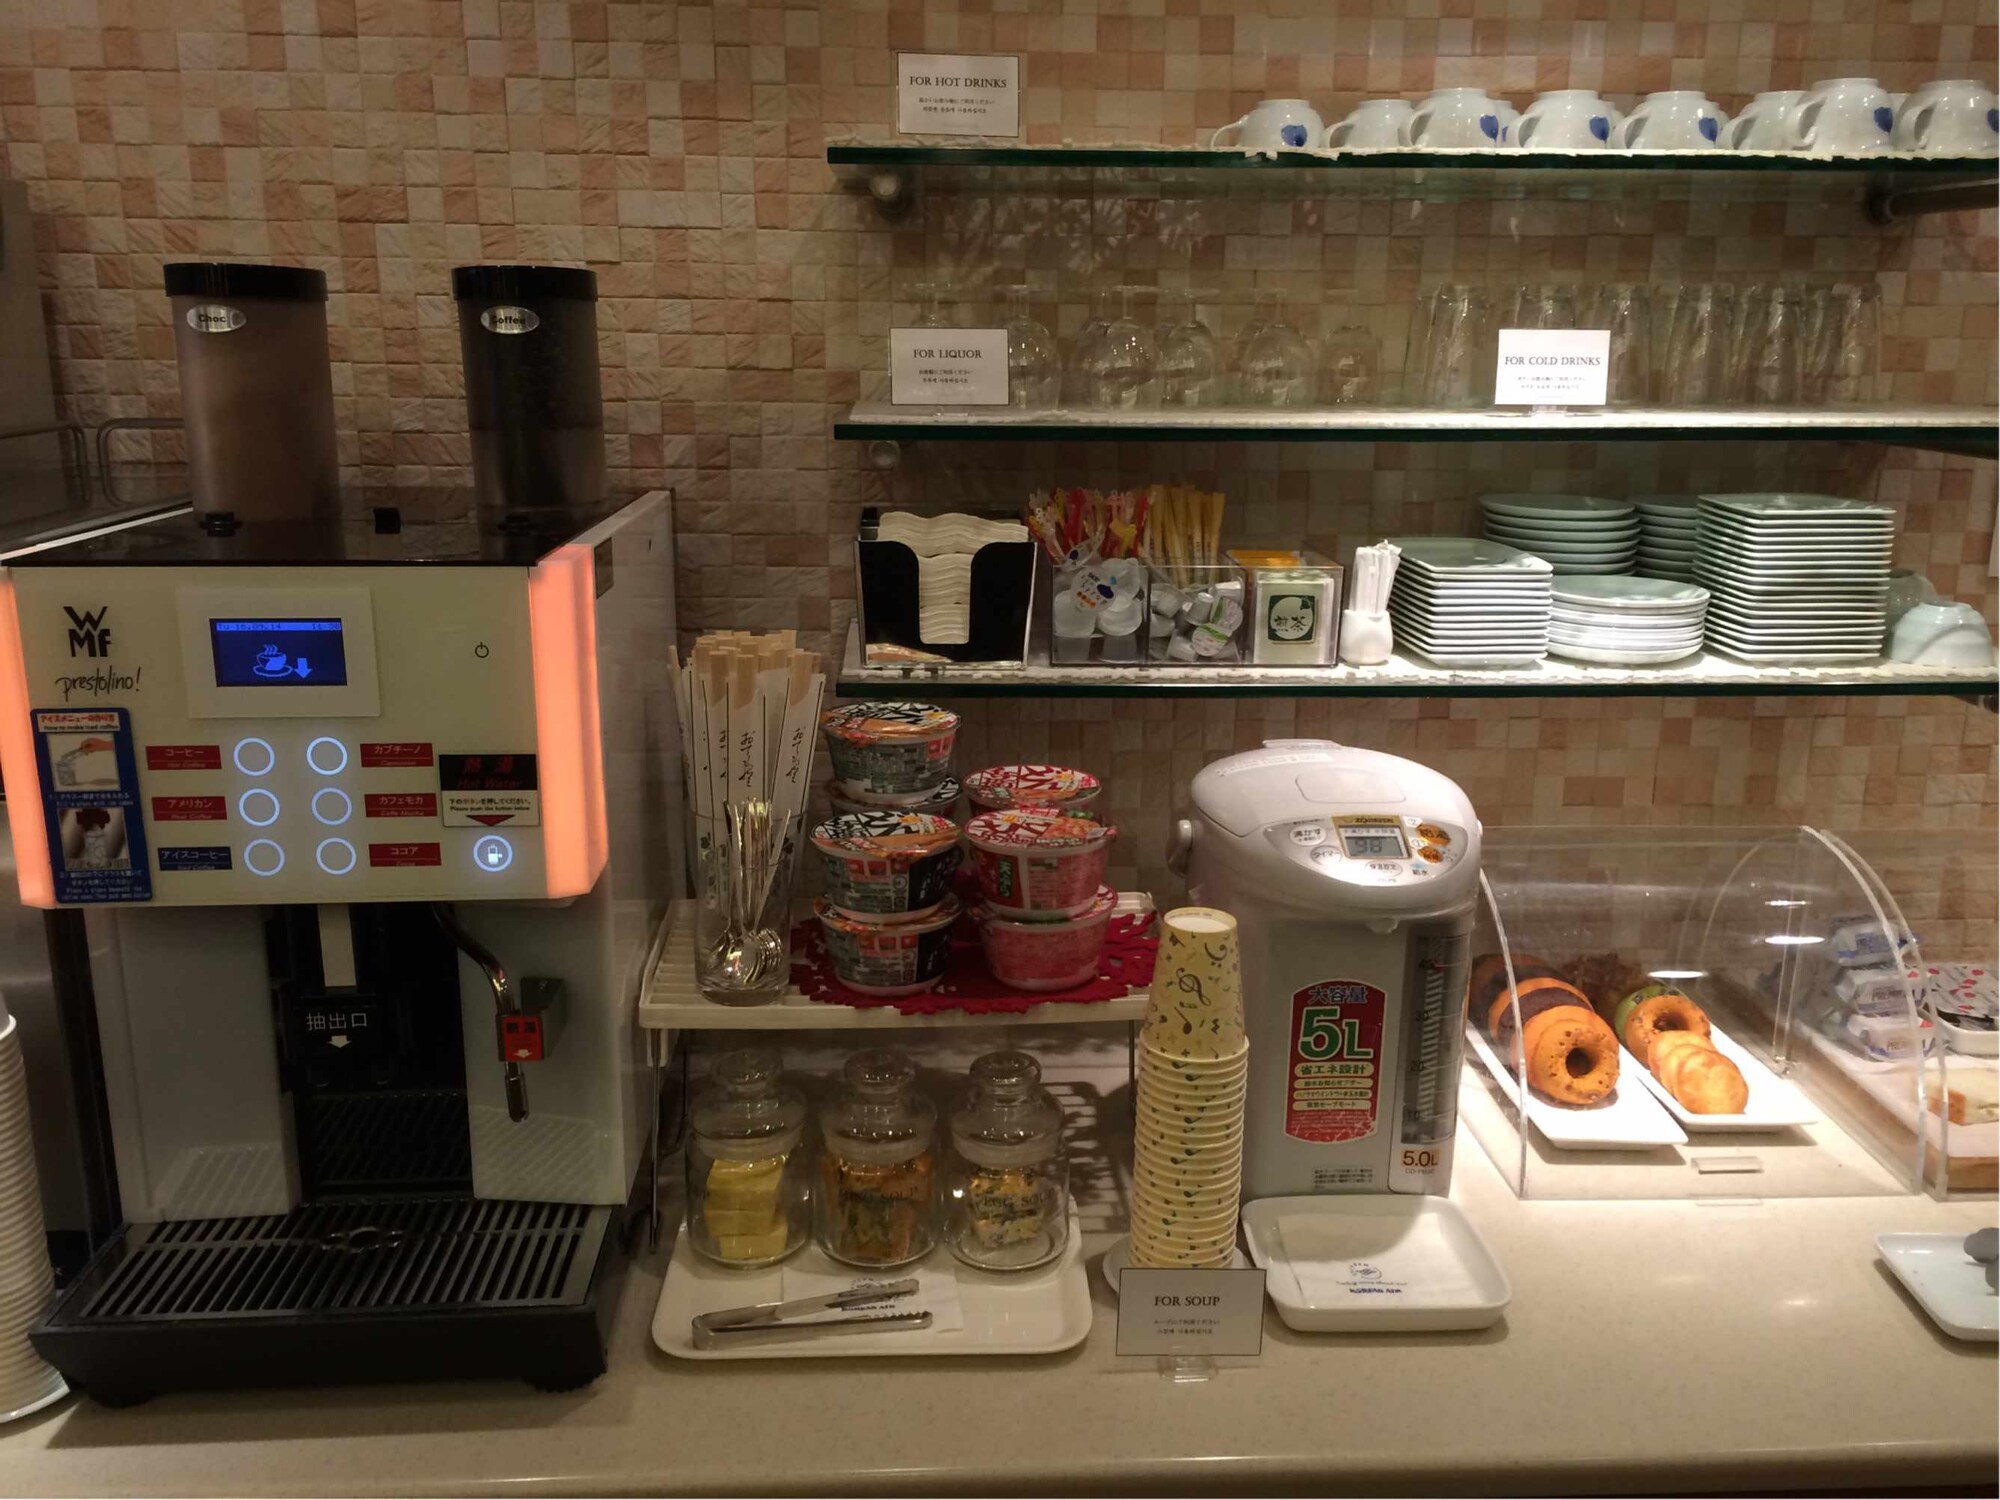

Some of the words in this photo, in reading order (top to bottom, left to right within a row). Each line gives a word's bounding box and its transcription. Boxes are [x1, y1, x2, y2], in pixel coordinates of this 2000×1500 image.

[909, 76, 932, 86] FOR
[935, 77, 960, 87] HOT
[964, 78, 1007, 88] DRINKS
[198, 314, 226, 323] Choc
[913, 349, 935, 359] FOR
[939, 349, 982, 359] LIQUOR
[1504, 356, 1525, 365] FOR
[1528, 356, 1558, 366] COLD
[1561, 356, 1601, 366] DRINKS
[63, 606, 112, 657] WMF
[55, 665, 141, 702] prestolino!
[165, 748, 205, 757] コーヒー
[167, 798, 213, 808] アメリカン
[378, 795, 424, 805] カフェモカ
[1354, 837, 1383, 853] 98
[161, 850, 229, 860] アイスコーヒー
[389, 846, 419, 855] ココア
[1307, 985, 1368, 1004] 大容量
[306, 1012, 367, 1031] 抽出口
[1298, 1006, 1375, 1060] 5L
[1301, 1064, 1366, 1075] 省エネ設計
[1403, 1151, 1439, 1166] 5.0L
[1154, 1296, 1181, 1306] FOR
[1185, 1296, 1221, 1306] SOUP
